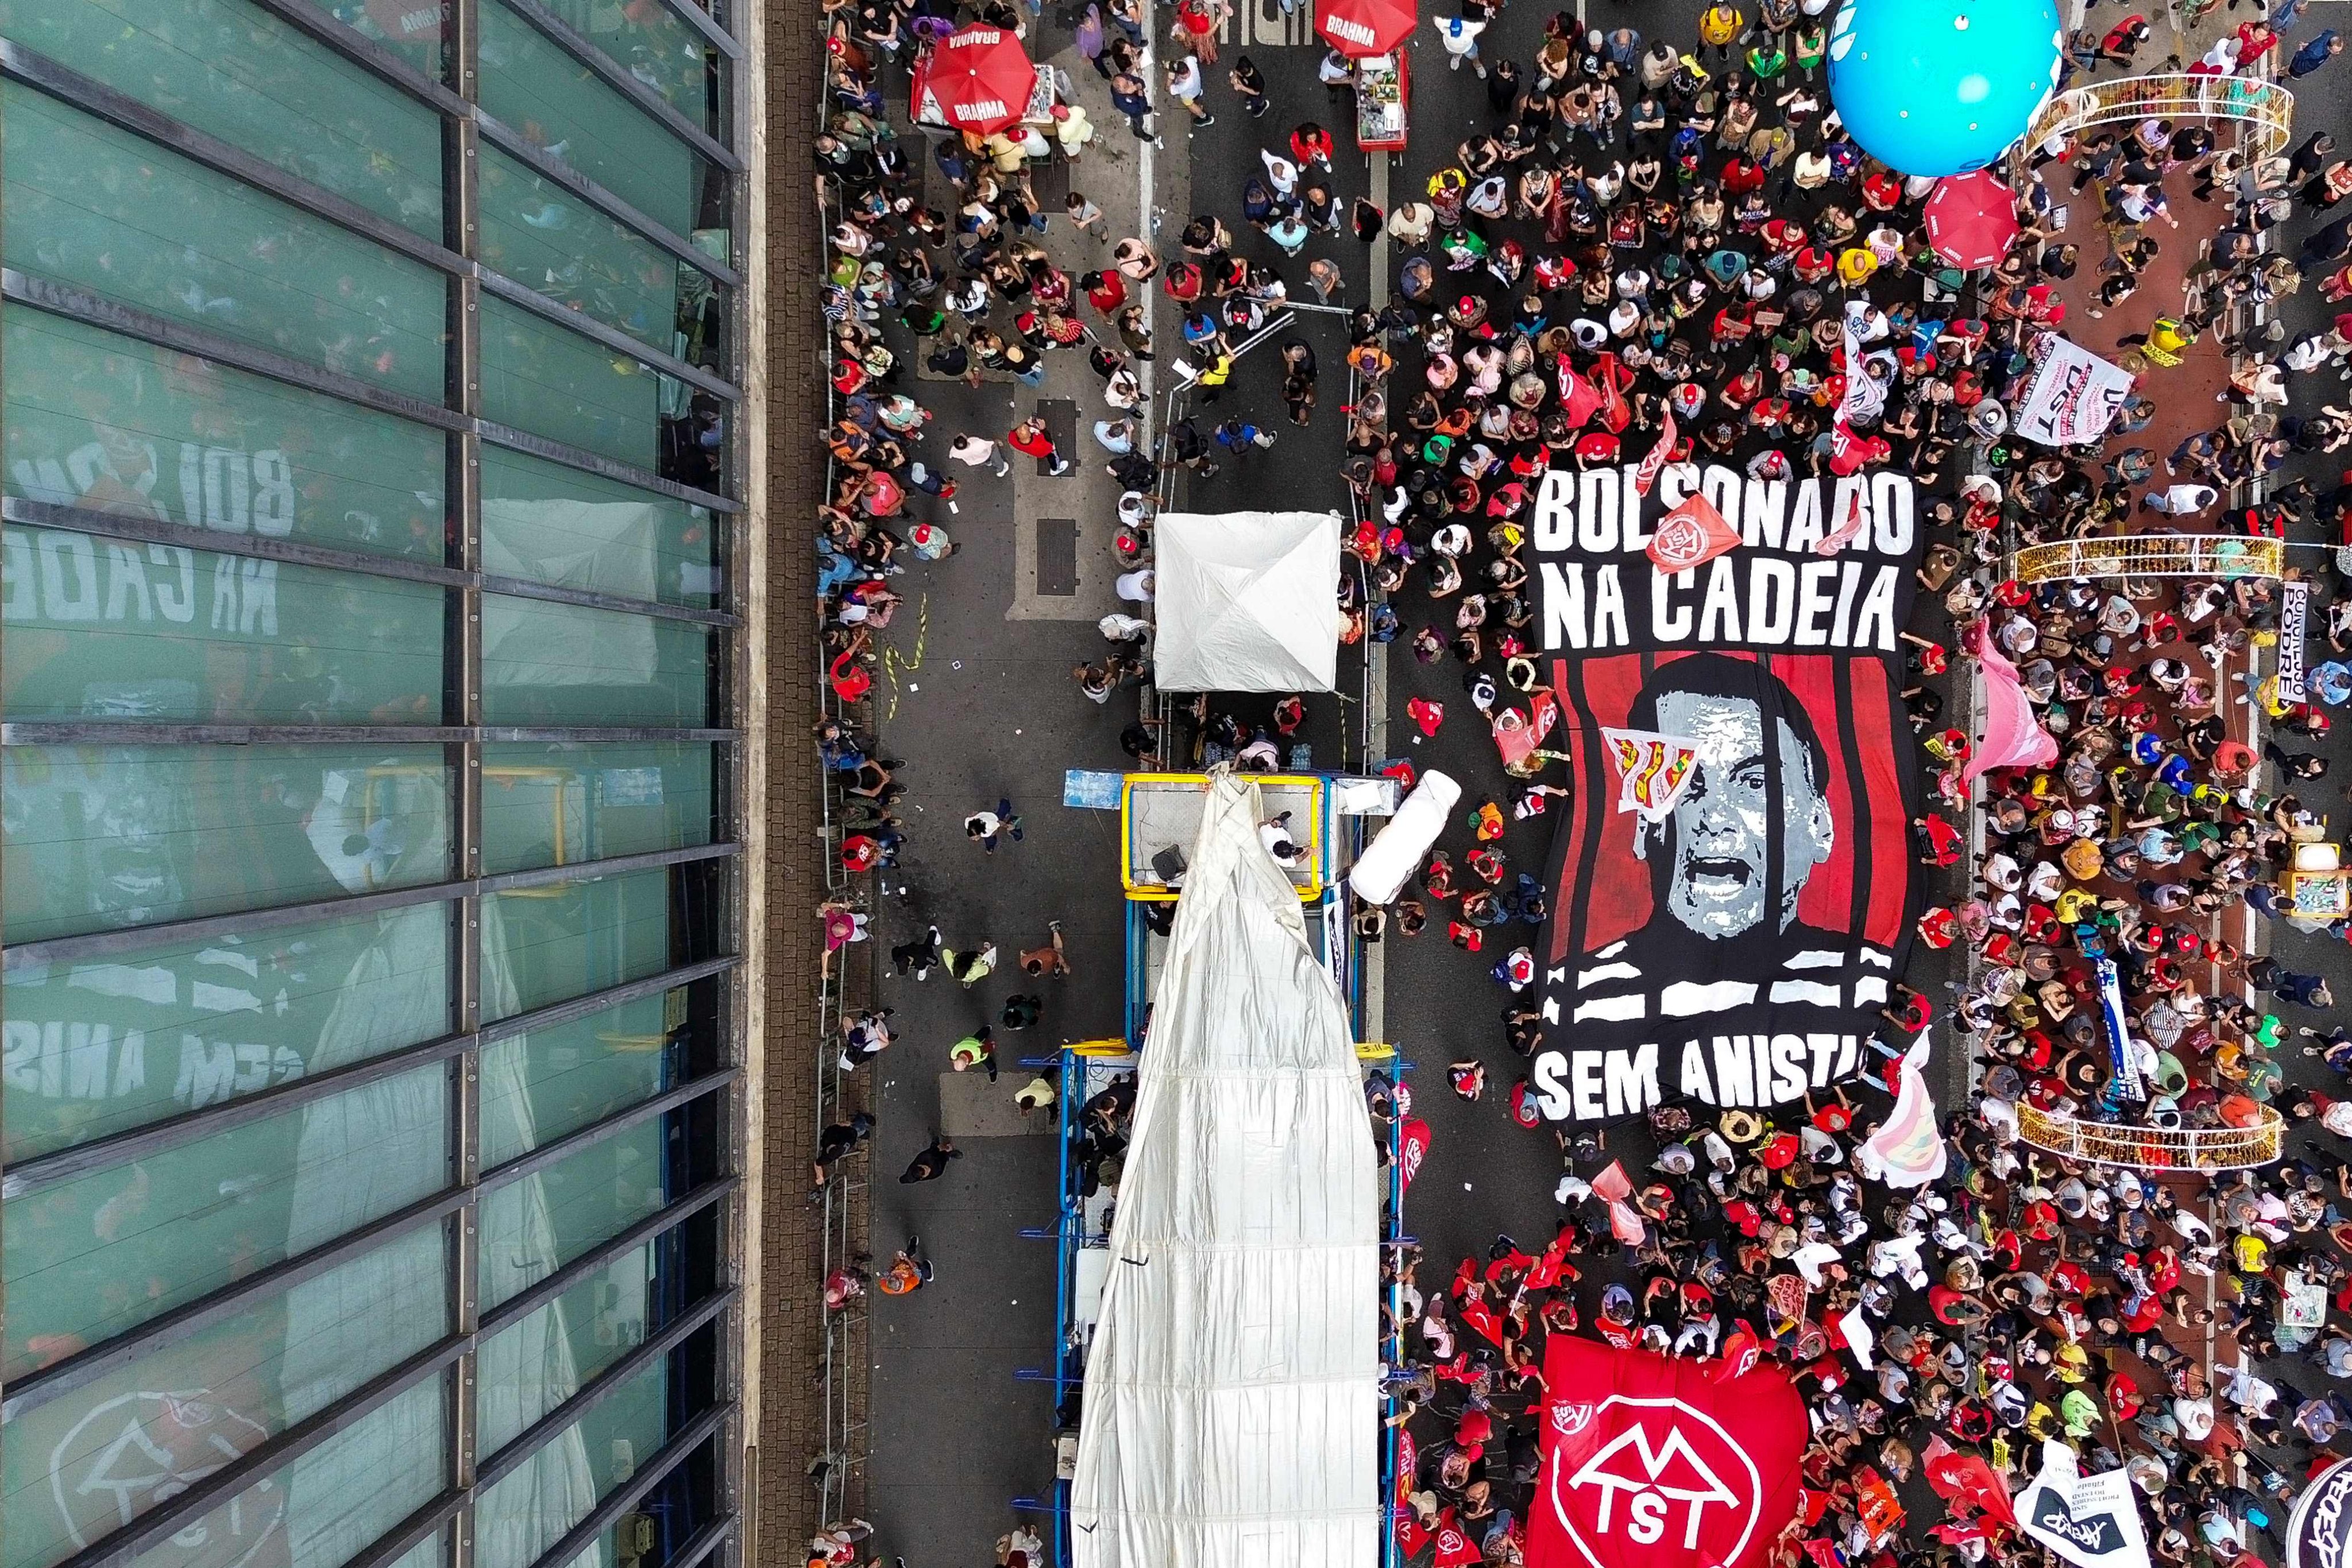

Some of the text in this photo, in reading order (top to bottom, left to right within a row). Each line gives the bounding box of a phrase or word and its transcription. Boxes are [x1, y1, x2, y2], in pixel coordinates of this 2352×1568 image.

[949, 30, 1001, 49] BRAHMA
[1326, 15, 1375, 48] BRAHMA
[954, 100, 1008, 122] BRAHMA
[1930, 215, 1939, 236] AMSTEL
[1942, 246, 1963, 262] AMSTEL
[1973, 255, 1994, 264] AMSTEL
[2038, 364, 2083, 439] UGT
[1540, 556, 1899, 651] NA CADEIA
[2279, 588, 2295, 694] PODRE
[1535, 1044, 1660, 1121] SEM
[1569, 1422, 1739, 1550] MTST
